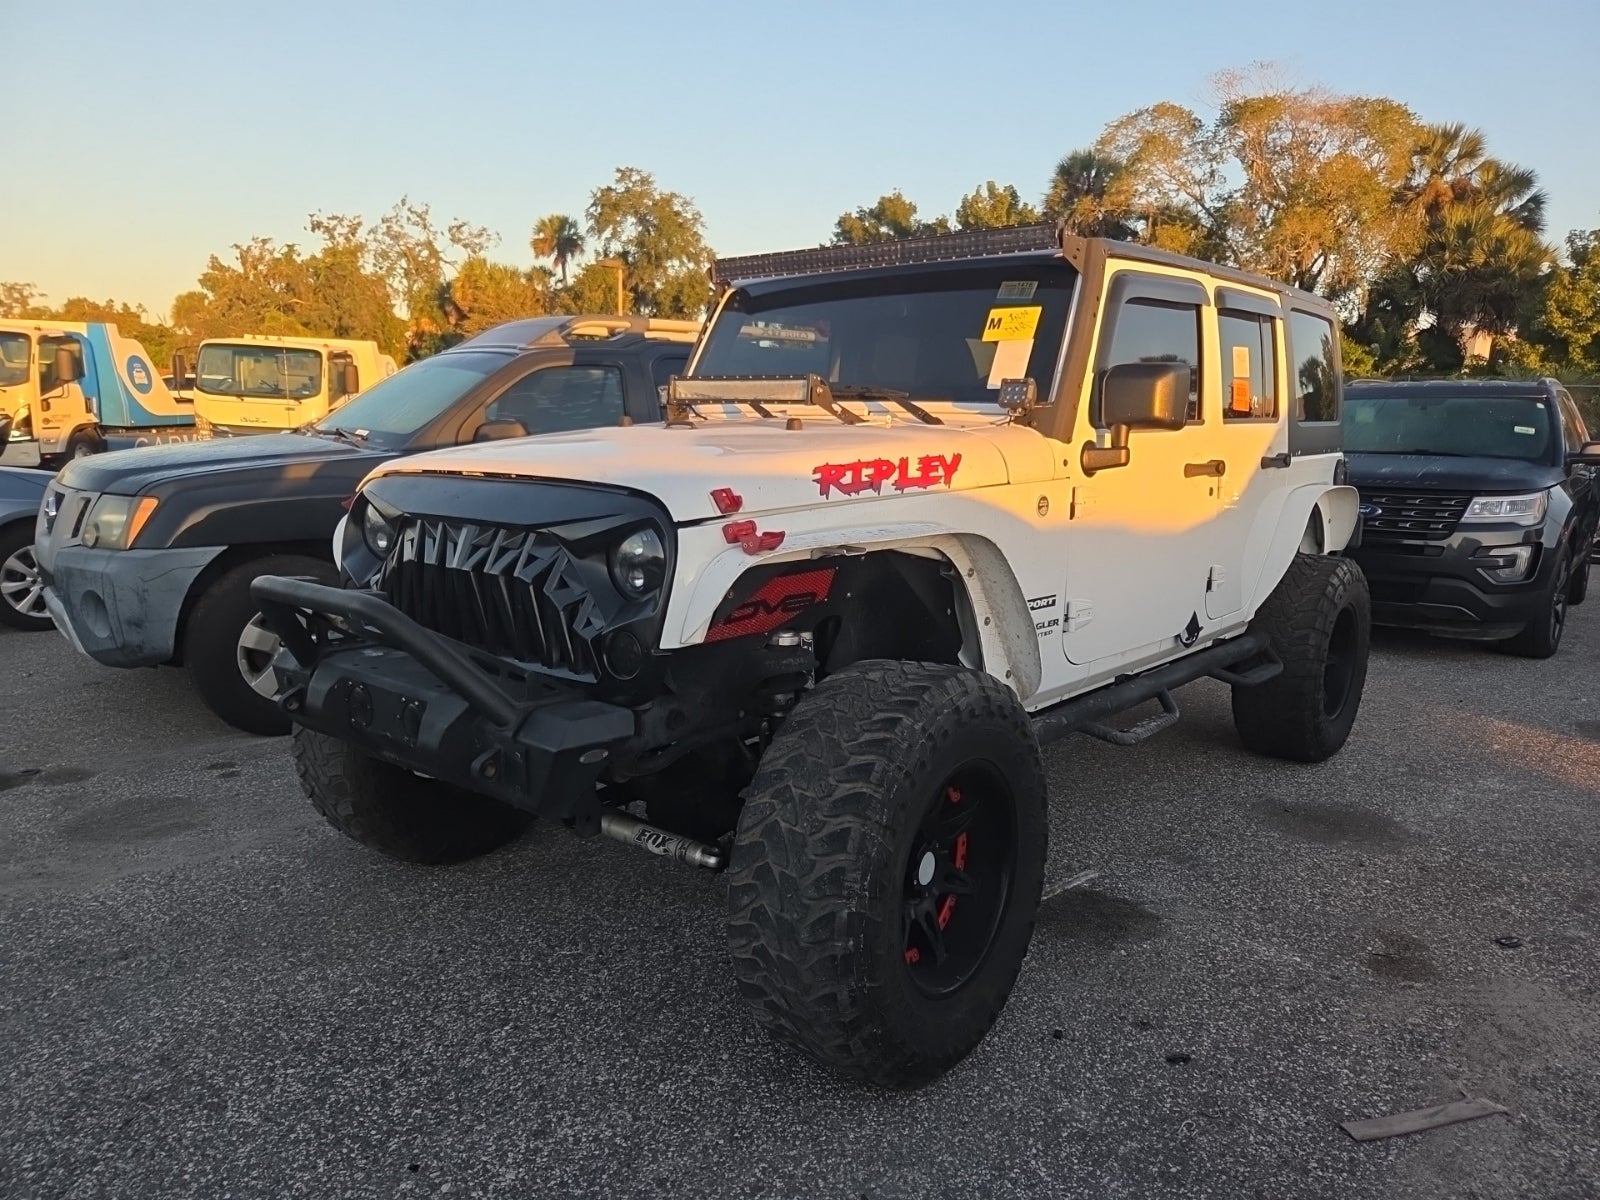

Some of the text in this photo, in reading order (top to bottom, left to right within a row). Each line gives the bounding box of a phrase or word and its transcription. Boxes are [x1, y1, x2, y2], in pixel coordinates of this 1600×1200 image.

[988, 317, 1003, 330] M
[812, 452, 962, 500] RIPLEY
[634, 828, 677, 849] FOX
